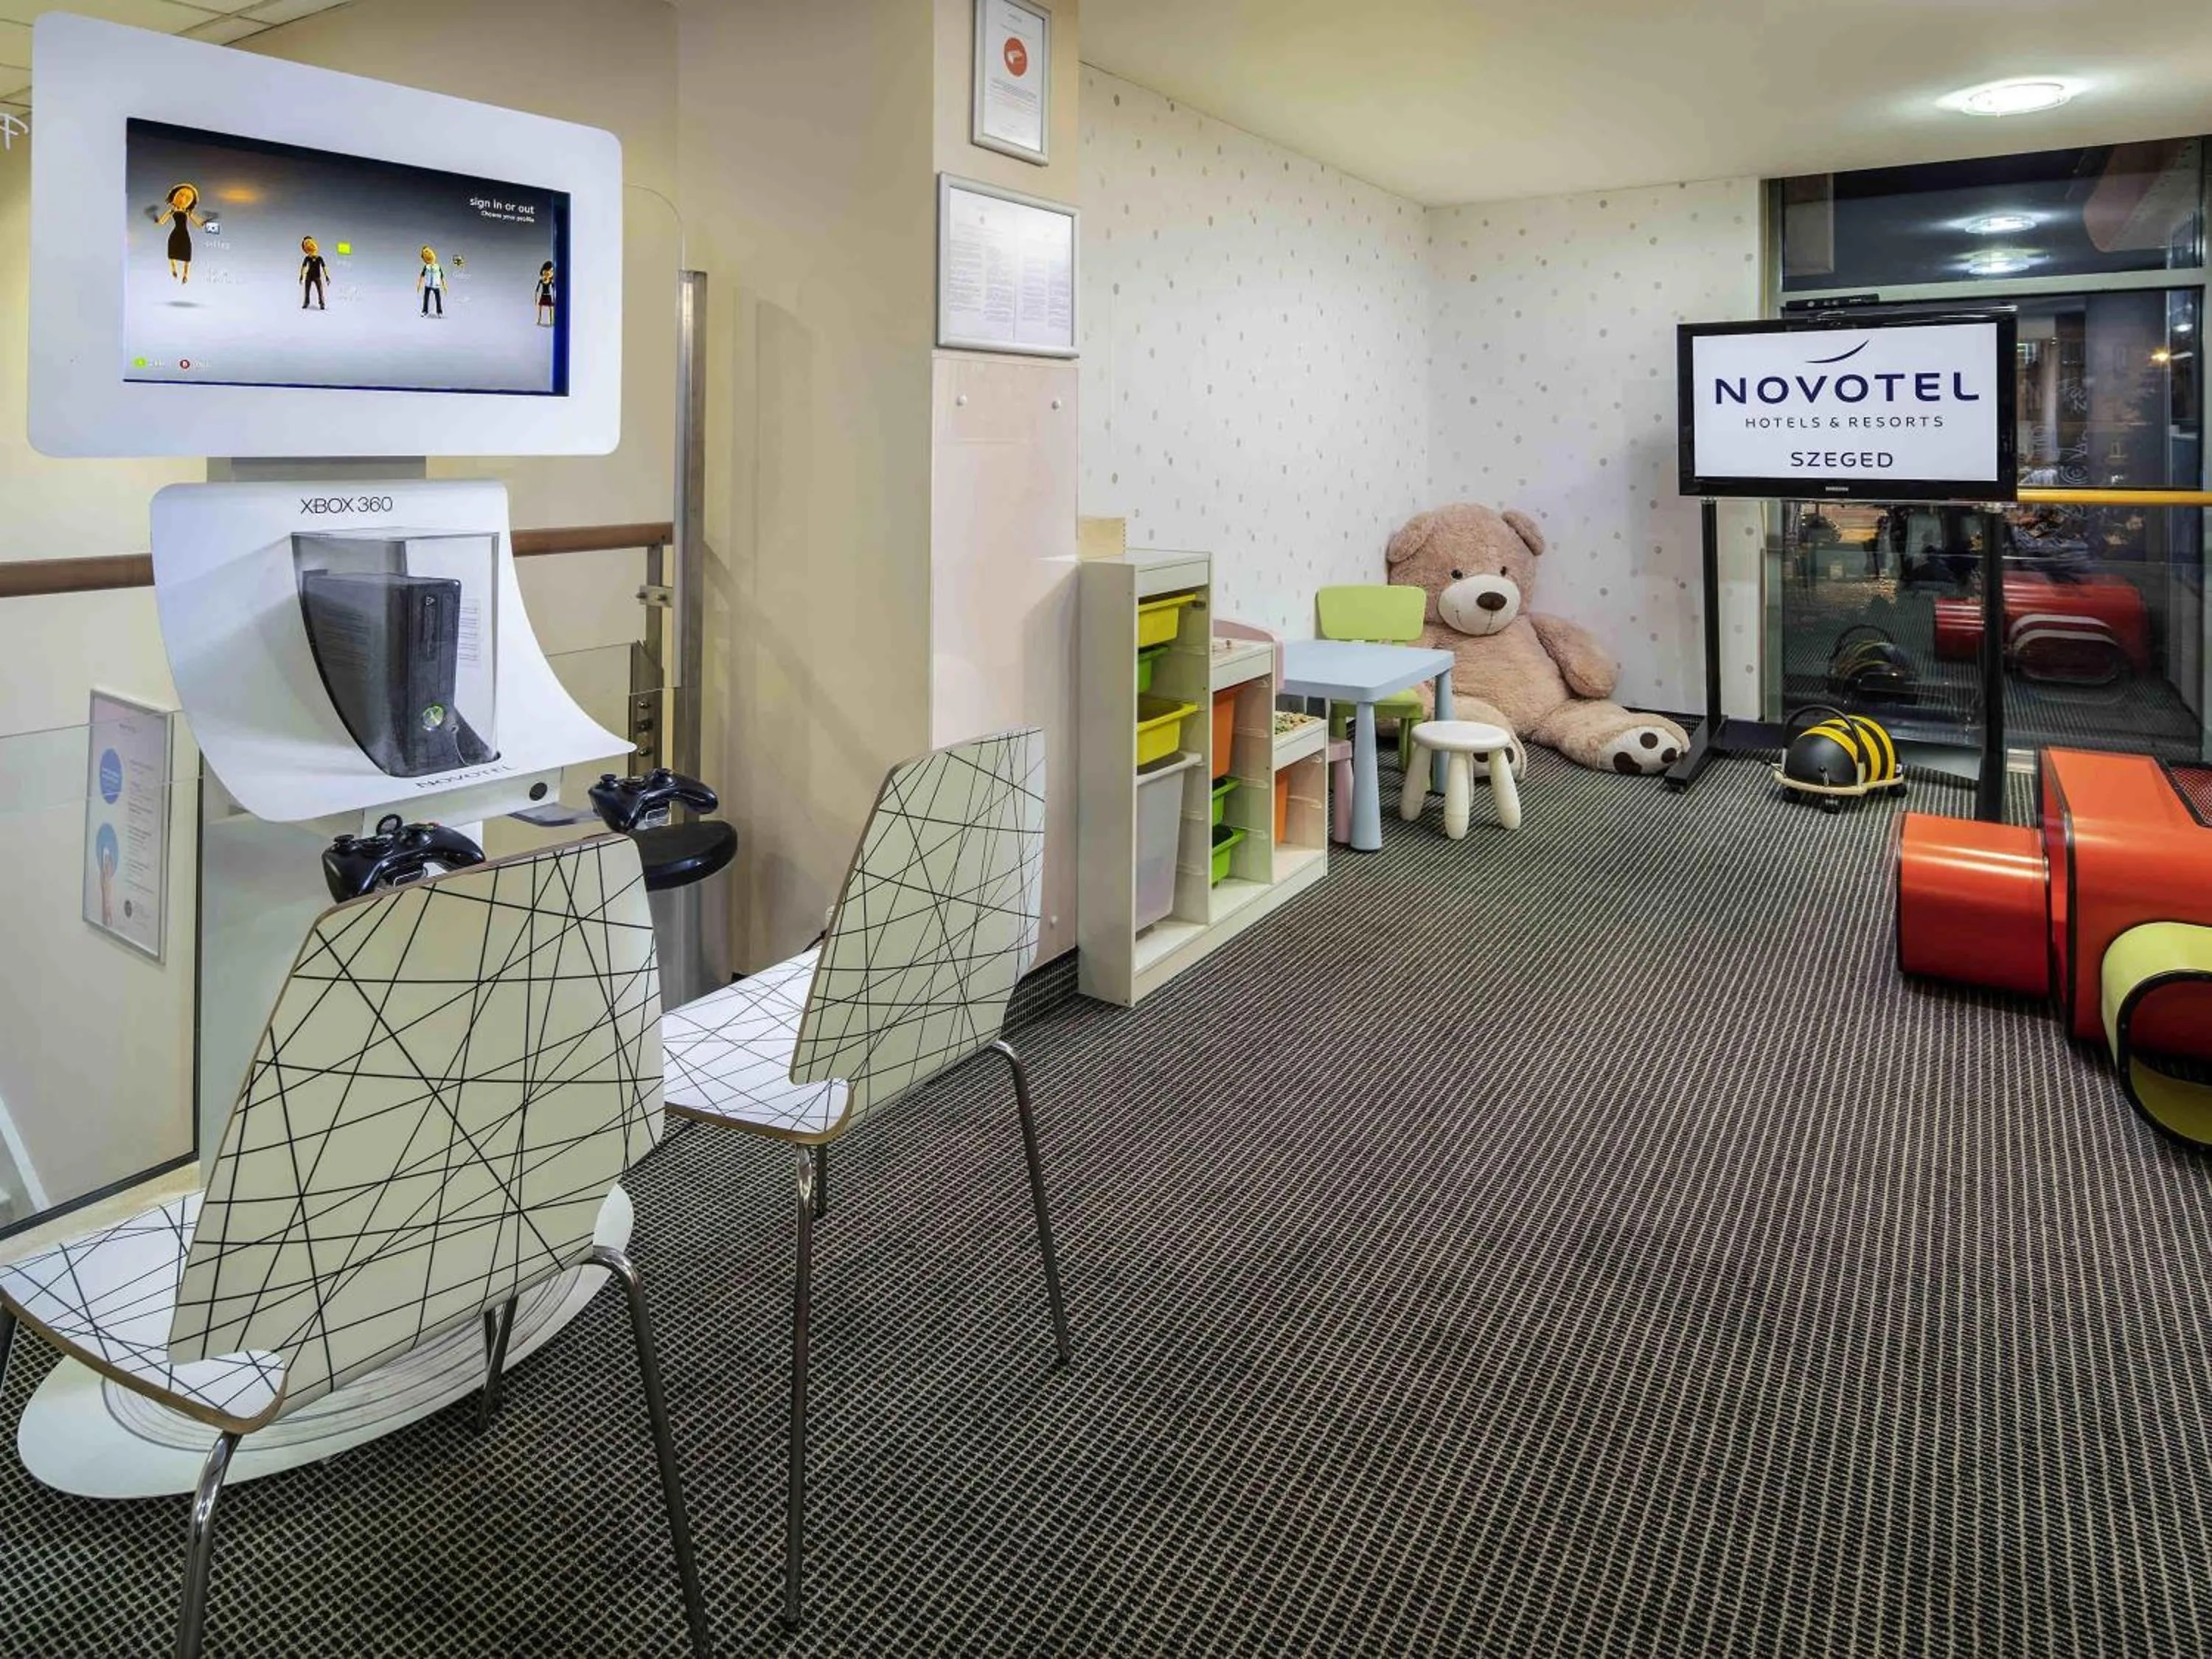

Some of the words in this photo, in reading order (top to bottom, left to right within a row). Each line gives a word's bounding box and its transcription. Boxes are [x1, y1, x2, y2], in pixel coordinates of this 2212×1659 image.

[470, 198, 490, 209] sign
[493, 198, 502, 210] in
[505, 202, 516, 212] or
[518, 206, 535, 214] out
[1714, 372, 1980, 405] NOVOTEL
[1745, 417, 1820, 428] HOTELS
[1829, 417, 1840, 428] &
[1848, 415, 1944, 428] RESORTS
[1790, 451, 1894, 468] SZEGED
[300, 498, 355, 515] XBOX
[358, 496, 393, 512] 360
